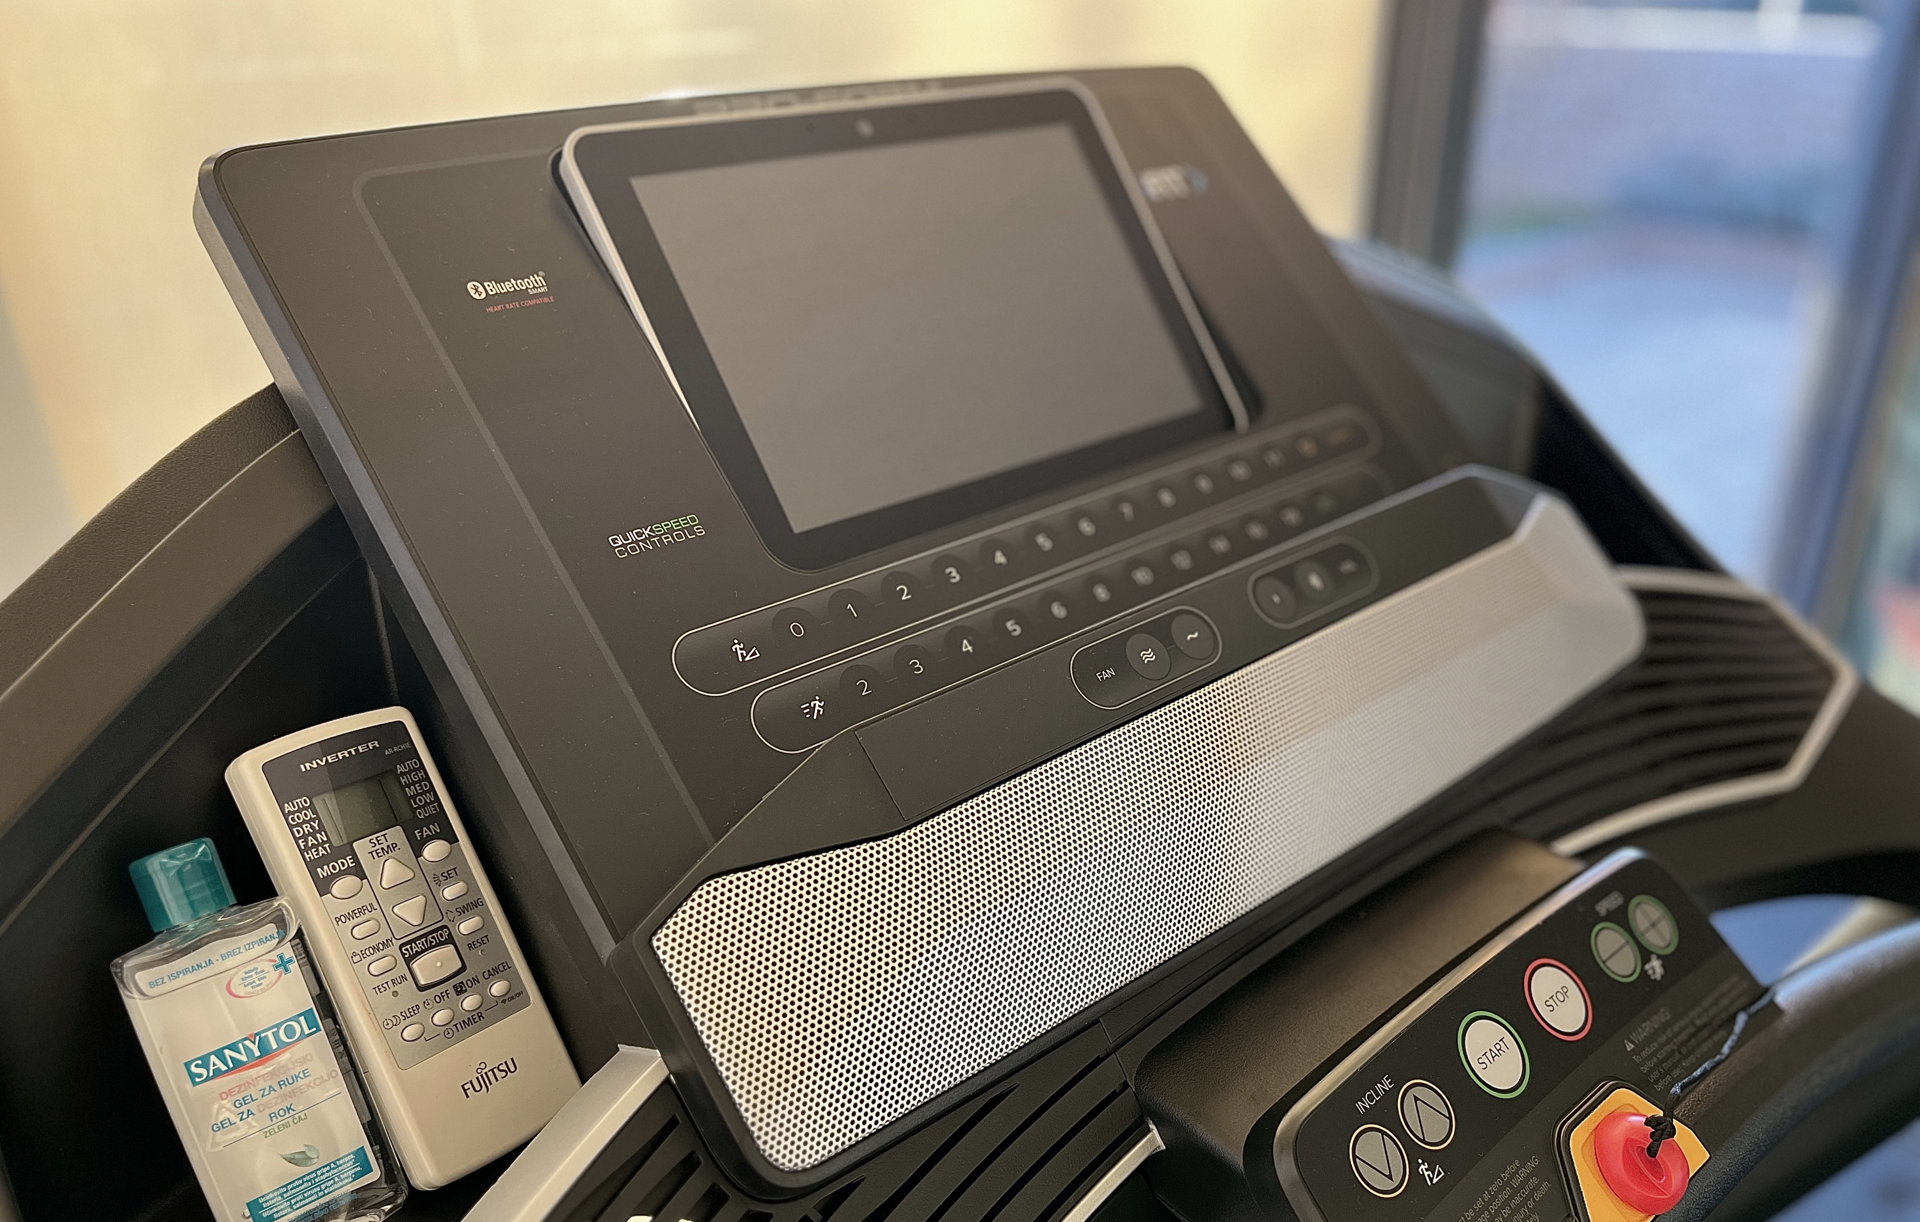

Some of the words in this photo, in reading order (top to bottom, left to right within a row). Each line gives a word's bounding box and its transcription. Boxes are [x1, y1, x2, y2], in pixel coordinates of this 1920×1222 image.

[483, 274, 547, 295] Bluetooth
[527, 286, 548, 295] SMART
[486, 304, 504, 313] HEART
[505, 301, 520, 310] RATE
[520, 296, 554, 307] COMPATIBLE
[608, 514, 699, 547] QUICKSPEED
[615, 525, 706, 558] CONTROLS
[789, 622, 805, 637] 0
[846, 603, 858, 617] 1
[896, 585, 912, 600] 2
[944, 567, 961, 583] 3
[994, 550, 1008, 566] 4
[1035, 532, 1053, 551] 5
[1118, 501, 1135, 521] 7
[856, 680, 872, 696] 2
[909, 659, 924, 674] 3
[962, 639, 973, 653] 4
[1005, 619, 1022, 636] 5
[1051, 601, 1067, 619] 6
[1095, 667, 1116, 683] FAN
[299, 740, 380, 772] INVERTER
[396, 759, 420, 774] AUTO
[400, 769, 426, 785] HIGH
[405, 781, 430, 797] MED
[284, 796, 311, 814] AUTO
[410, 791, 435, 808] LOW
[288, 808, 317, 825] COOL
[416, 802, 440, 819] QUIET
[292, 820, 320, 838] DRY
[414, 822, 440, 840] FAN
[298, 831, 328, 850] FAN
[369, 833, 389, 848] SET
[304, 843, 332, 862] HEAT
[368, 842, 401, 861] TEMP.
[317, 855, 356, 879] MODE
[440, 867, 459, 882] SET
[334, 902, 378, 926] POWERFUL
[455, 898, 485, 917] SWING
[360, 937, 395, 960] ECONOMY
[401, 928, 450, 958] START/STOP
[467, 935, 491, 951] RESET
[148, 977, 166, 989] BEZ
[167, 958, 214, 982] ISPIRANJA
[220, 947, 243, 962] BREZ
[482, 960, 512, 981] CANCEL
[372, 982, 391, 996] TEST
[390, 974, 409, 988] RUN
[465, 975, 481, 989] ON
[434, 989, 451, 1004] OFF
[1544, 985, 1570, 1013] STOP
[400, 1001, 421, 1021] SLEEP
[453, 1011, 485, 1033] TIMER
[190, 1015, 317, 1082] SANYTOL
[1477, 1037, 1510, 1070] START
[460, 1057, 518, 1099] FUJITSU
[233, 1094, 258, 1109] GEL
[259, 1085, 277, 1098] ZA
[278, 1068, 312, 1090] RUKE
[1355, 1074, 1396, 1115] INCLINE
[211, 1117, 236, 1133] GEL
[237, 1109, 256, 1122] ZA
[268, 1103, 297, 1122] ROK
[263, 1120, 291, 1138] ZELENI
[1464, 1208, 1475, 1221] be
[1473, 1198, 1485, 1212] set
[1488, 1179, 1502, 1195] zero
[1500, 1159, 1521, 1182] before
[1501, 1205, 1512, 1218] be
[1527, 1197, 1535, 1208] or
